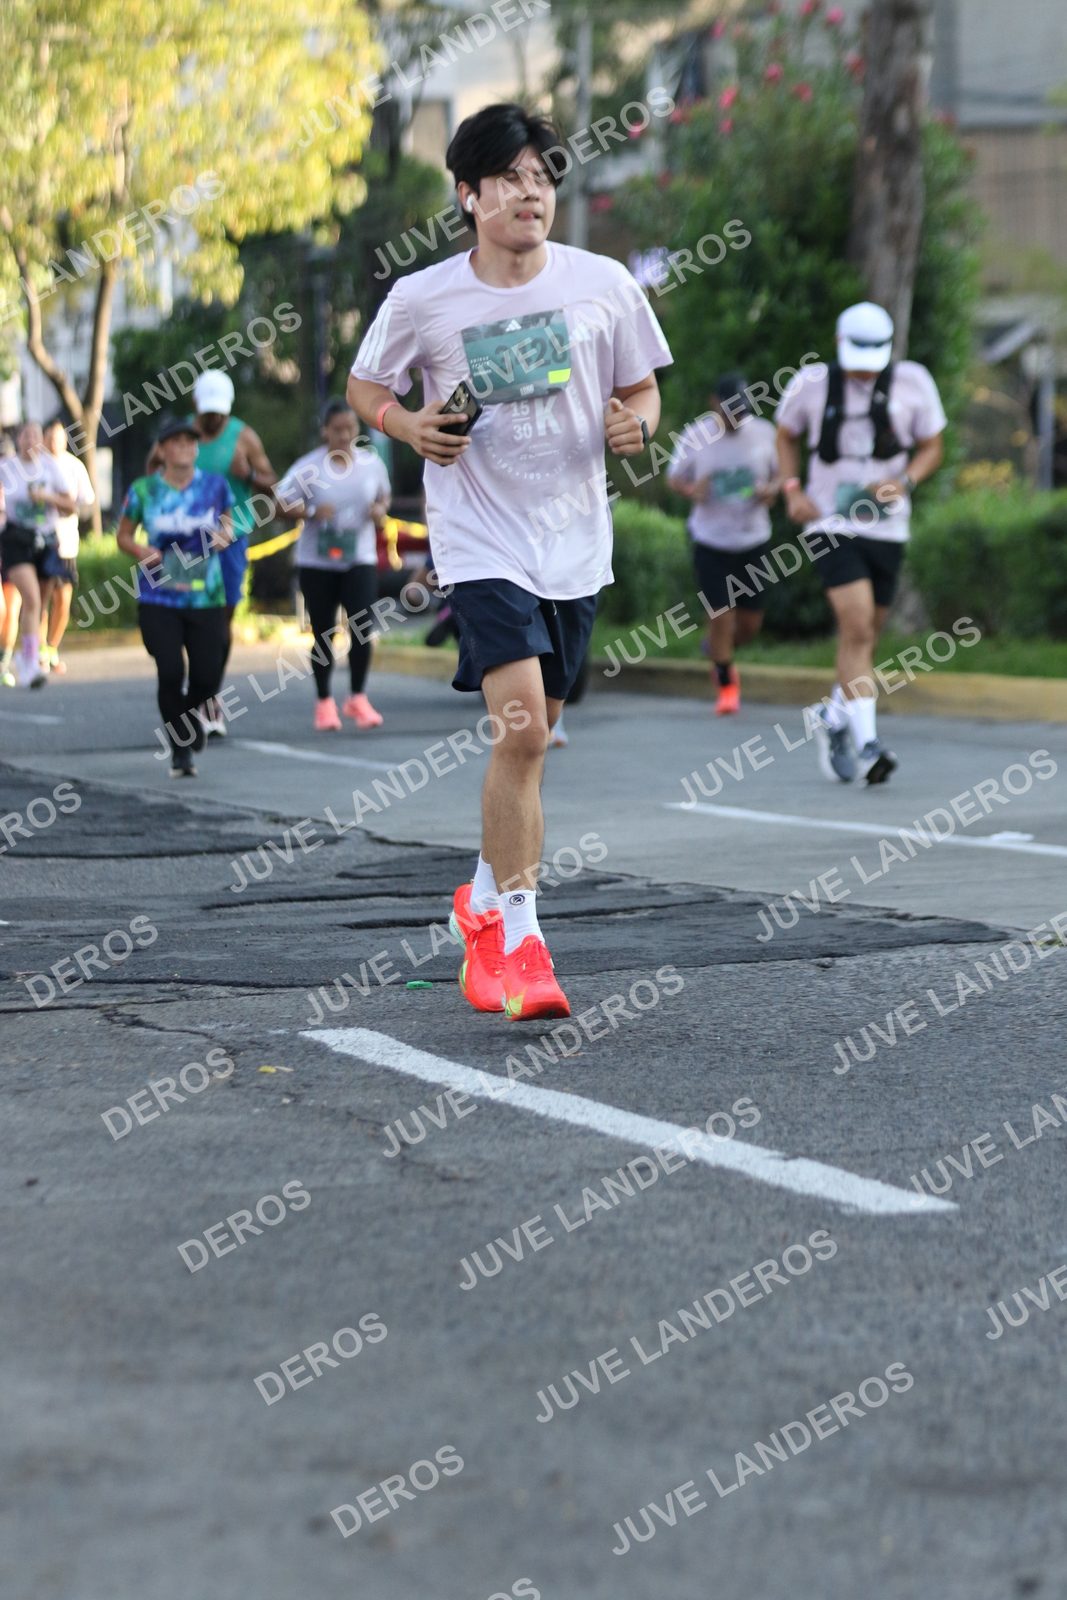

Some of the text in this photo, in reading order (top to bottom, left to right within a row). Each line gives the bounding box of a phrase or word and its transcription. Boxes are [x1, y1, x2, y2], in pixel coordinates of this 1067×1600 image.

[510, 400, 530, 417] 15
[535, 395, 563, 437] K
[512, 422, 532, 441] 30
